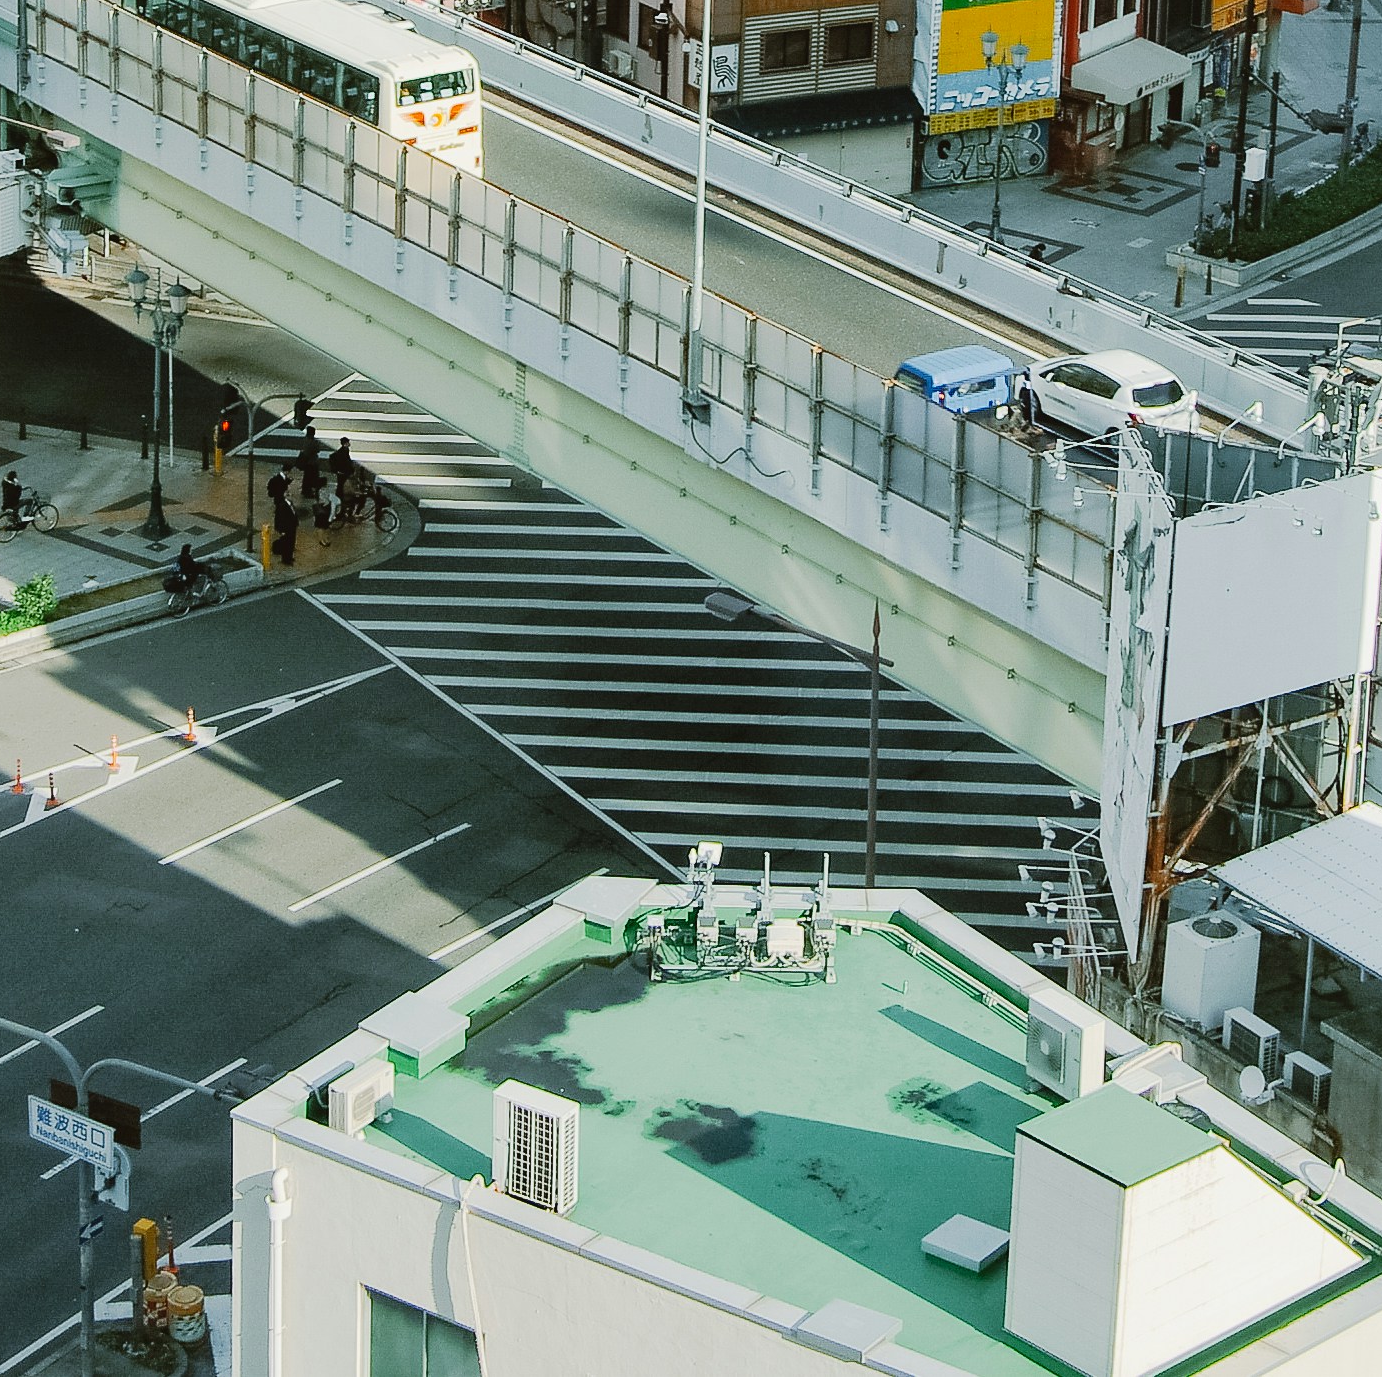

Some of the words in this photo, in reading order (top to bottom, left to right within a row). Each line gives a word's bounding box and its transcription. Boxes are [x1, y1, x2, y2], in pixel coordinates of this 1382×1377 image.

[938, 75, 1052, 112] ニッコーカメラ
[37, 1104, 105, 1149] 難波西口
